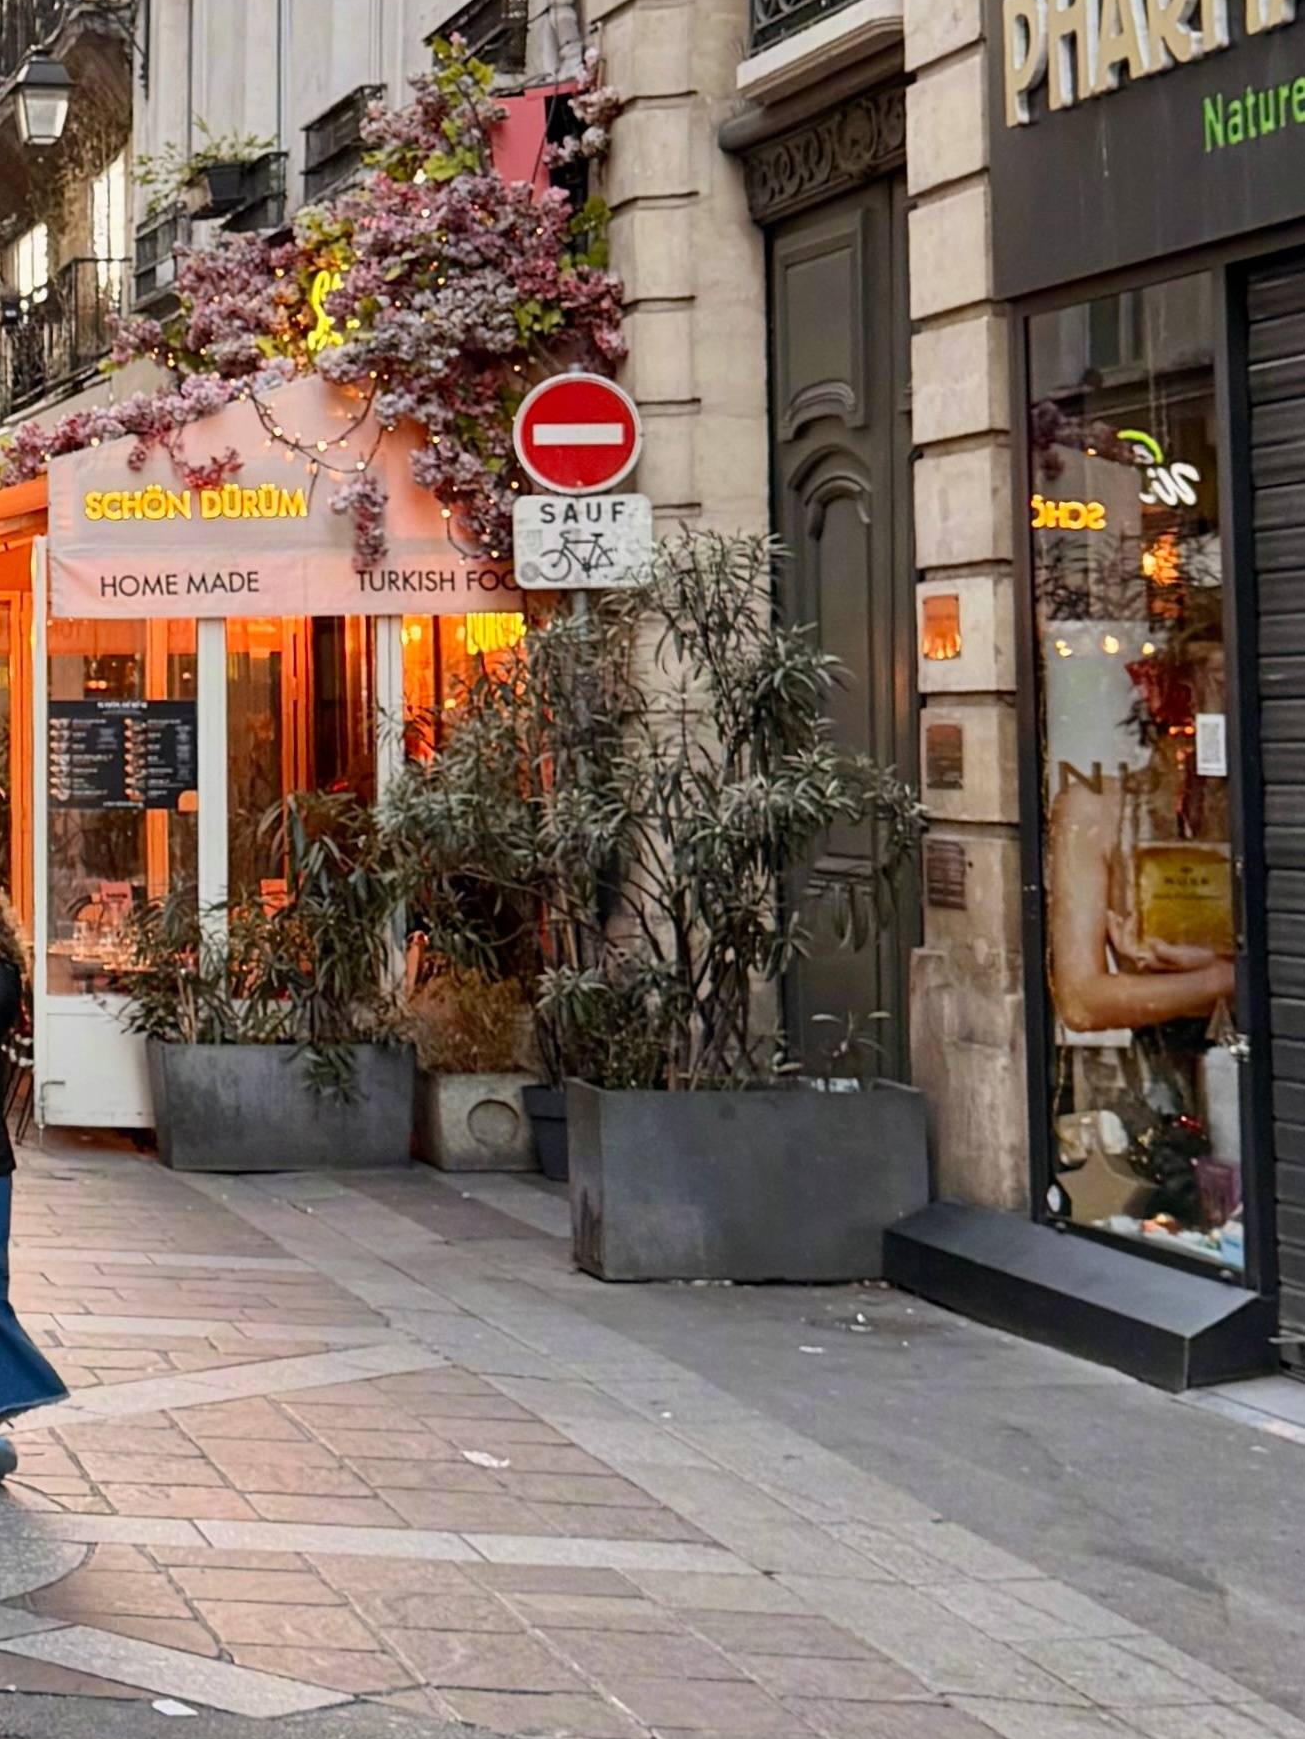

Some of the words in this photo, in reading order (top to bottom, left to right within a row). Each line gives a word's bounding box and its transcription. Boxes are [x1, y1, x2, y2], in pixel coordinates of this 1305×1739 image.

[84, 483, 192, 521] SCHÖN
[200, 483, 309, 520] DÜRÜM
[540, 501, 626, 524] SAUF
[100, 573, 179, 597] HOME
[186, 571, 260, 595] MADE
[356, 569, 456, 592] TURKISH
